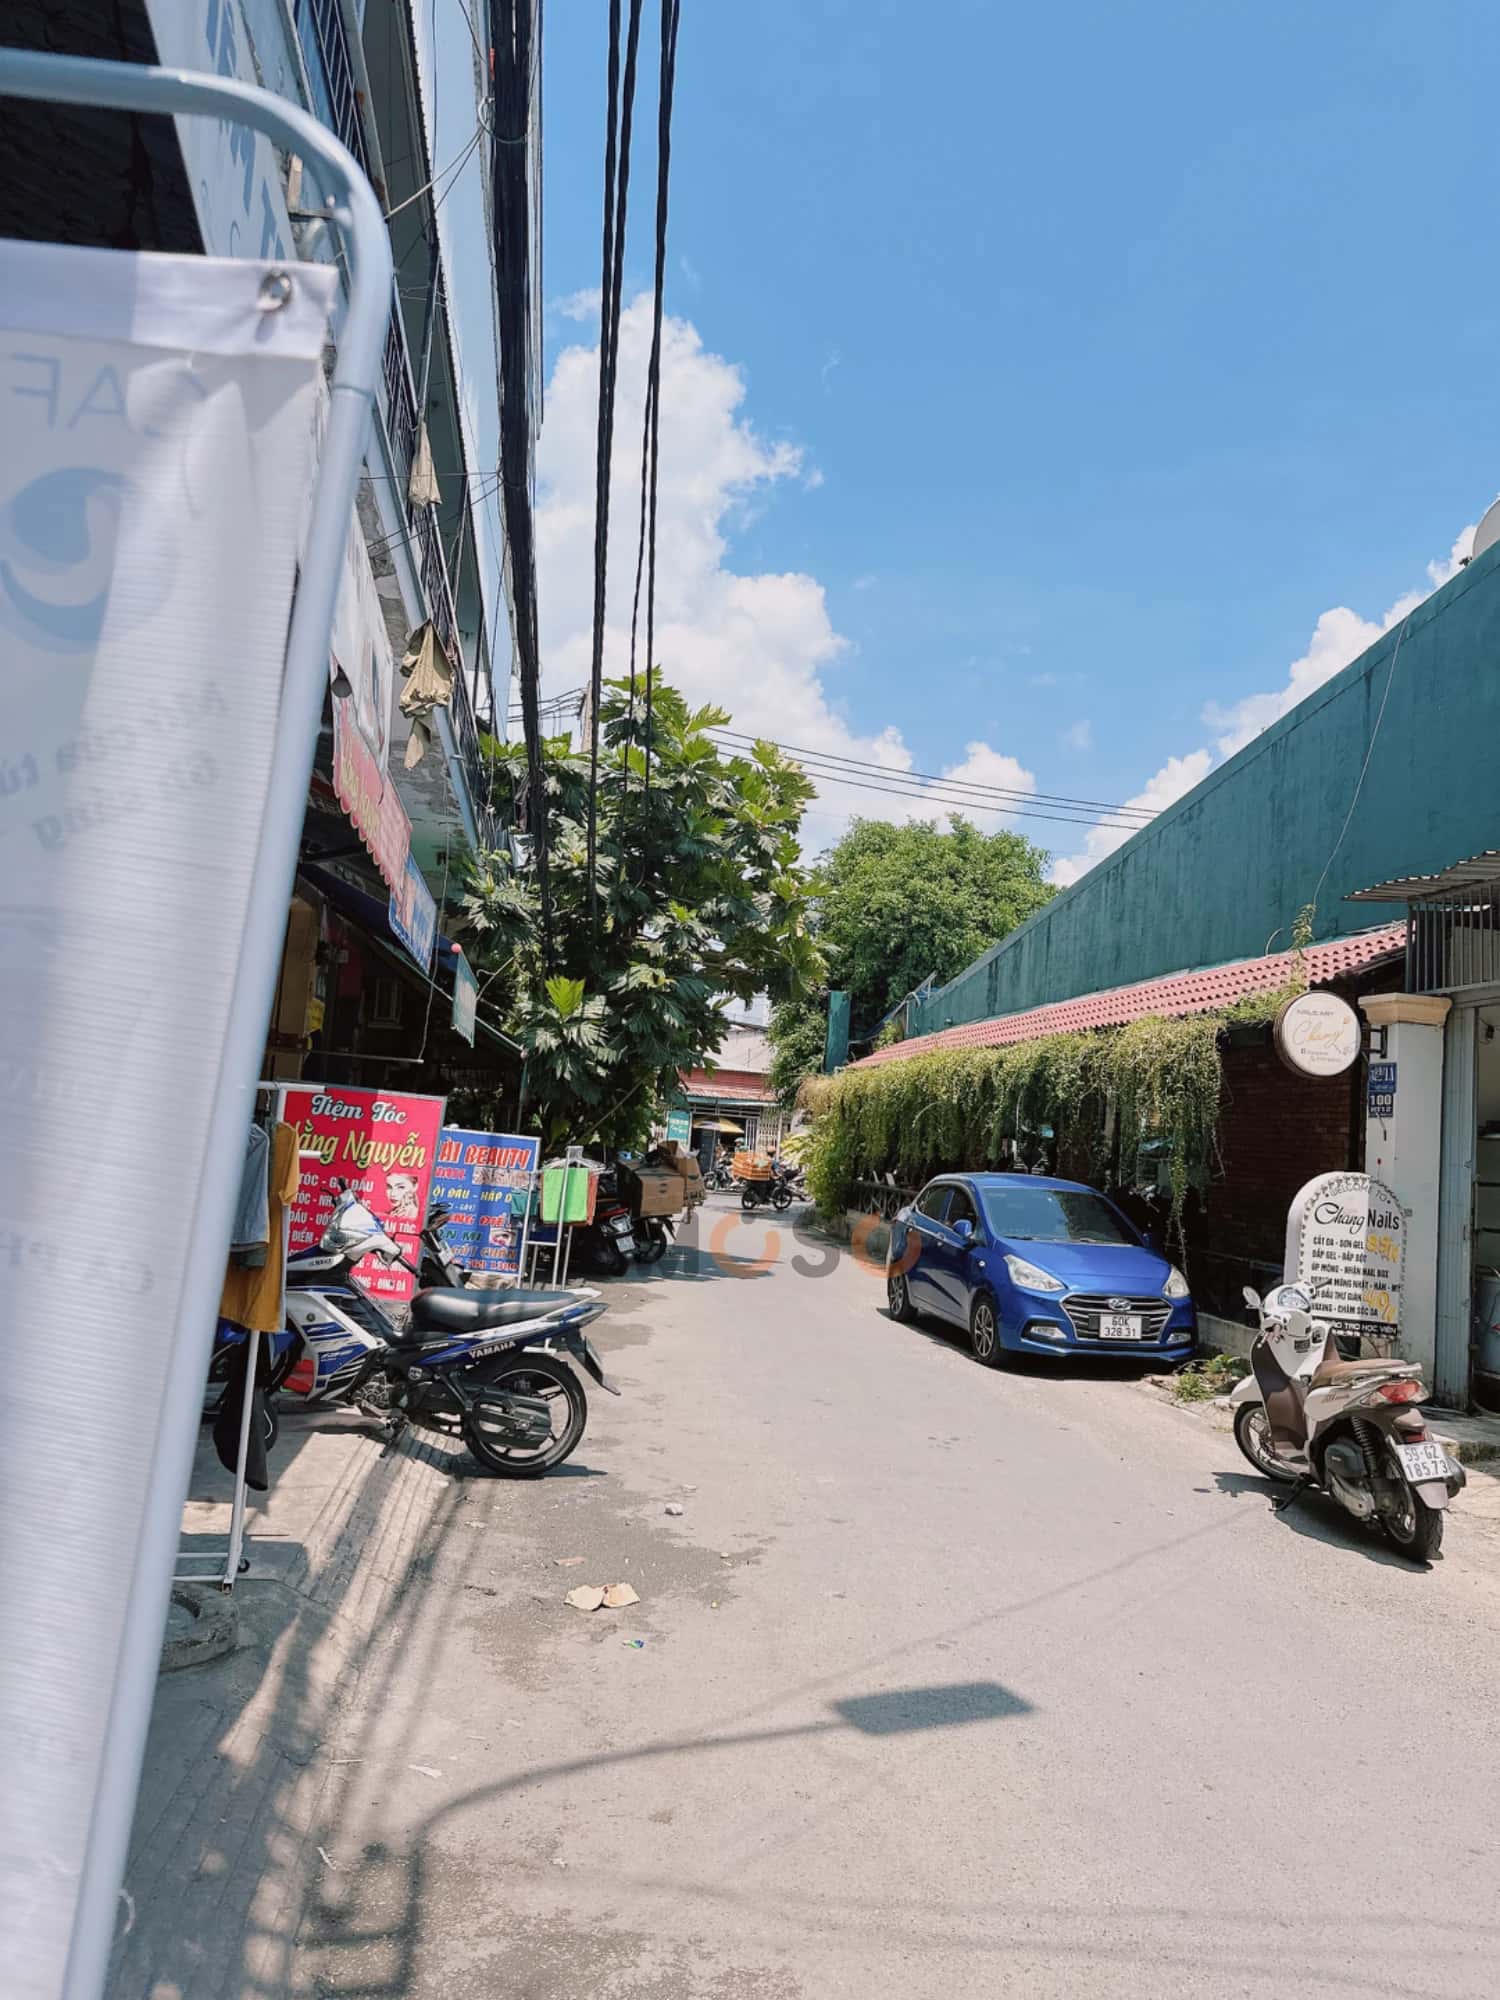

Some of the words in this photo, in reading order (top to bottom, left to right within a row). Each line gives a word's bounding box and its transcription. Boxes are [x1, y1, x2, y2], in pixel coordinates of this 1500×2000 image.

[311, 1094, 364, 1122] Tiệm
[371, 1101, 407, 1125] Tóc
[295, 1118, 340, 1165] ằng
[341, 1129, 426, 1172] Nguyễn
[464, 1144, 531, 1169] BEAUTY
[1314, 1202, 1365, 1235] Chang
[1366, 1207, 1400, 1230] Nails
[468, 1341, 517, 1359] YAMAHA
